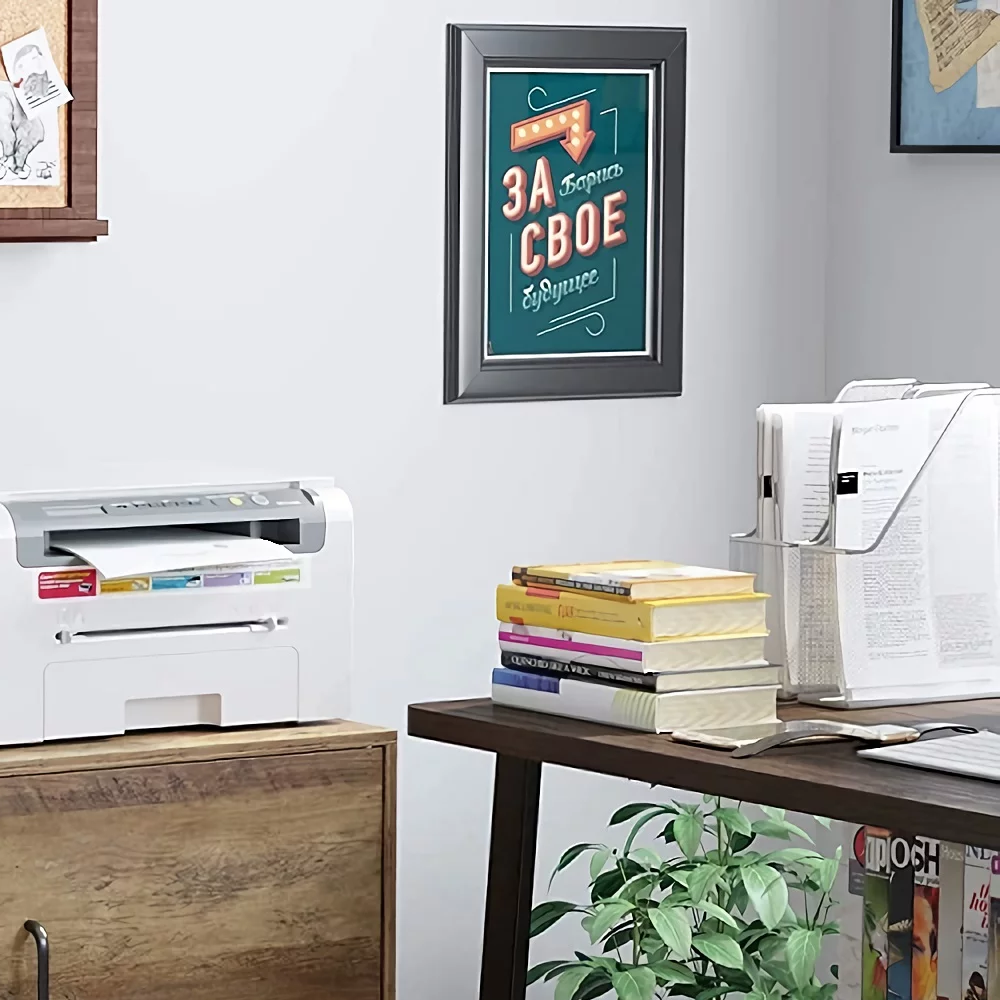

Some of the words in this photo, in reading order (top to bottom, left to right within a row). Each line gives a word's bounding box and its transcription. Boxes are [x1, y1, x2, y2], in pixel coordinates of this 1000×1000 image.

[502, 156, 557, 221] ЗА
[520, 189, 627, 277] СВОЕ
[522, 268, 600, 313] будущее
